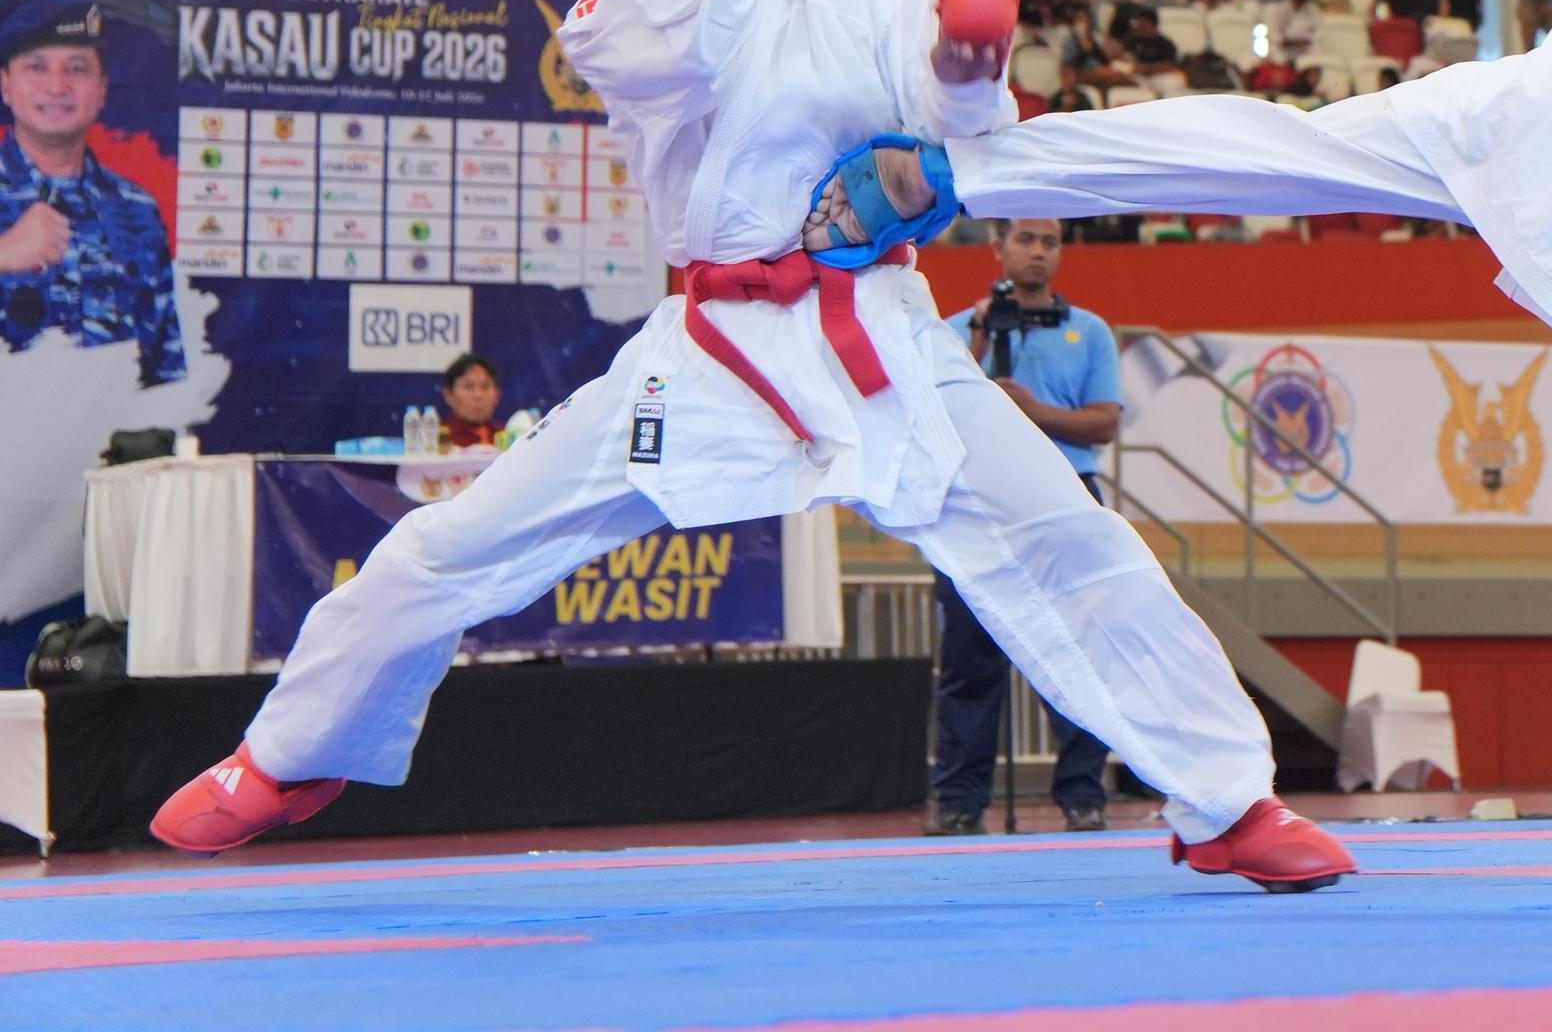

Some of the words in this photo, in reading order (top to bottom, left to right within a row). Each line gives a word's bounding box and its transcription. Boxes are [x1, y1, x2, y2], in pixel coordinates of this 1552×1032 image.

[176, 4, 342, 84] KASAU
[349, 26, 415, 82] CUP
[421, 30, 508, 83] 2026
[406, 311, 460, 345] BRI
[554, 576, 722, 625] WASIT
